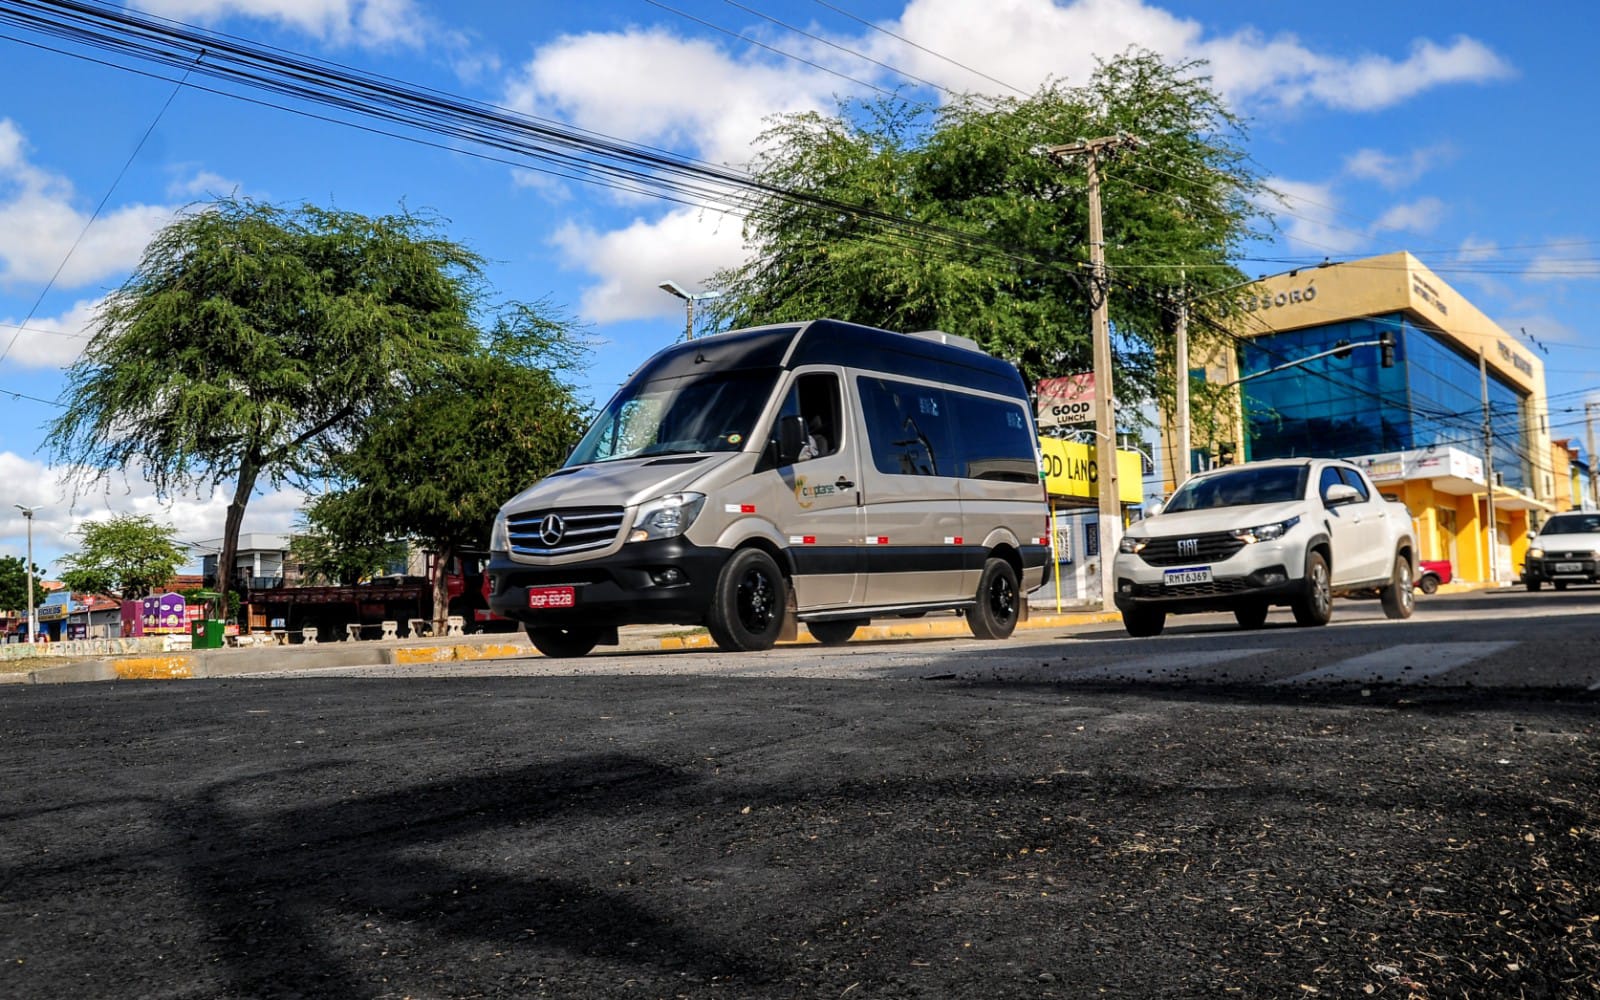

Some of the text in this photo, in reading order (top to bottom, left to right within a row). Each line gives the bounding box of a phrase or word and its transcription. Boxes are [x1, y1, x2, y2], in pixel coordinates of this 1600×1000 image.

[1052, 403, 1090, 416] GOOD
[1057, 414, 1086, 424] LUNCH
[1177, 538, 1199, 557] FIAT
